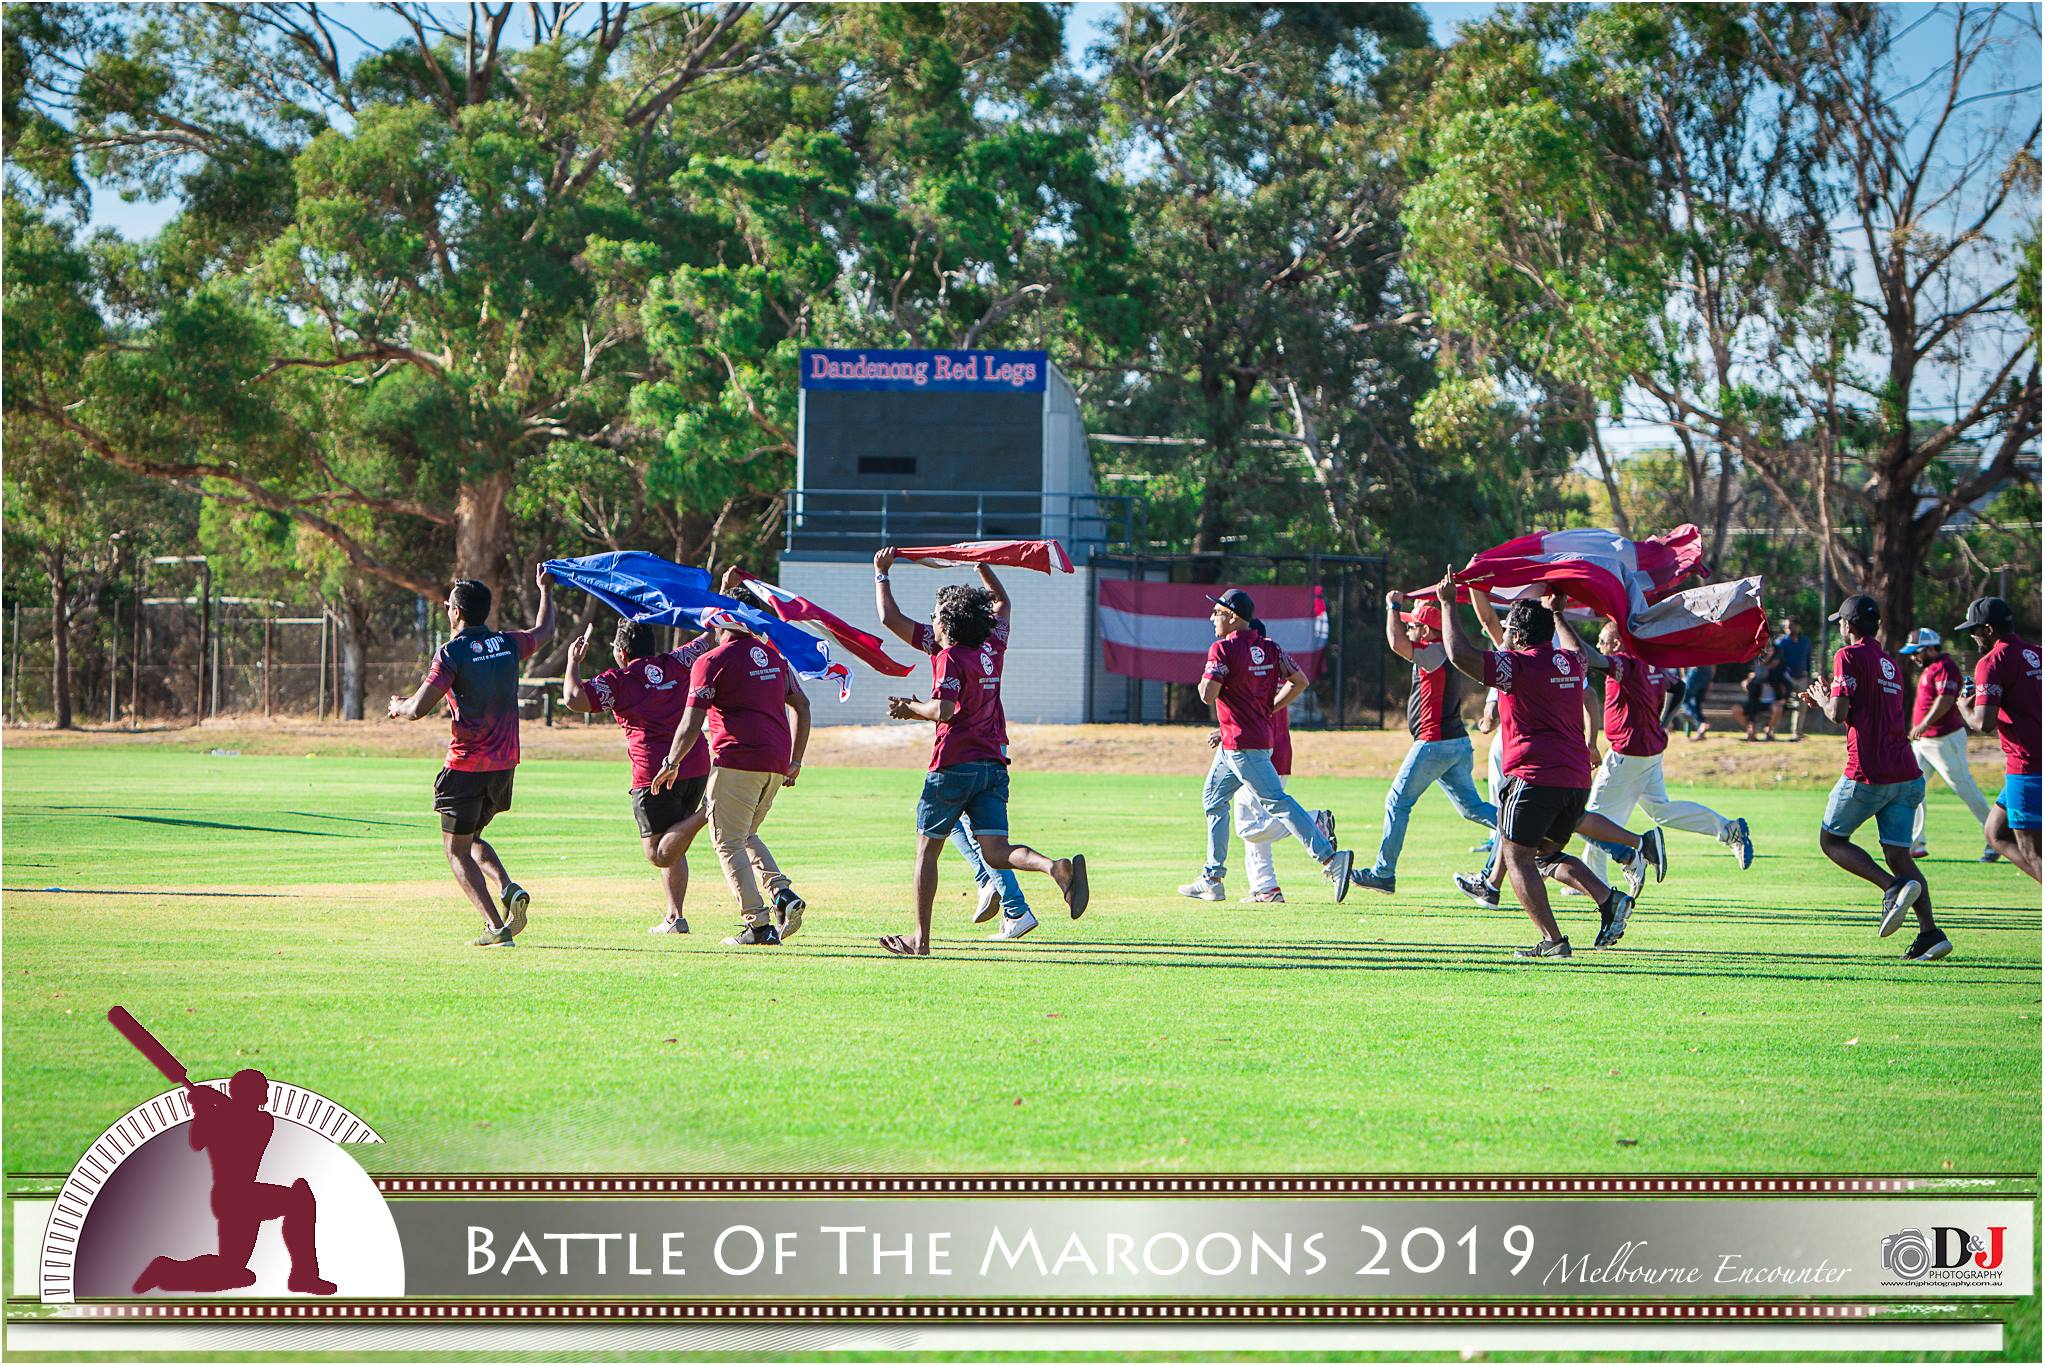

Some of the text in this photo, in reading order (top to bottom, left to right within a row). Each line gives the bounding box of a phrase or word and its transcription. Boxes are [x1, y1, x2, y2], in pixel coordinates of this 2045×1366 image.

[811, 354, 1037, 387] Dandenong Red Legs
